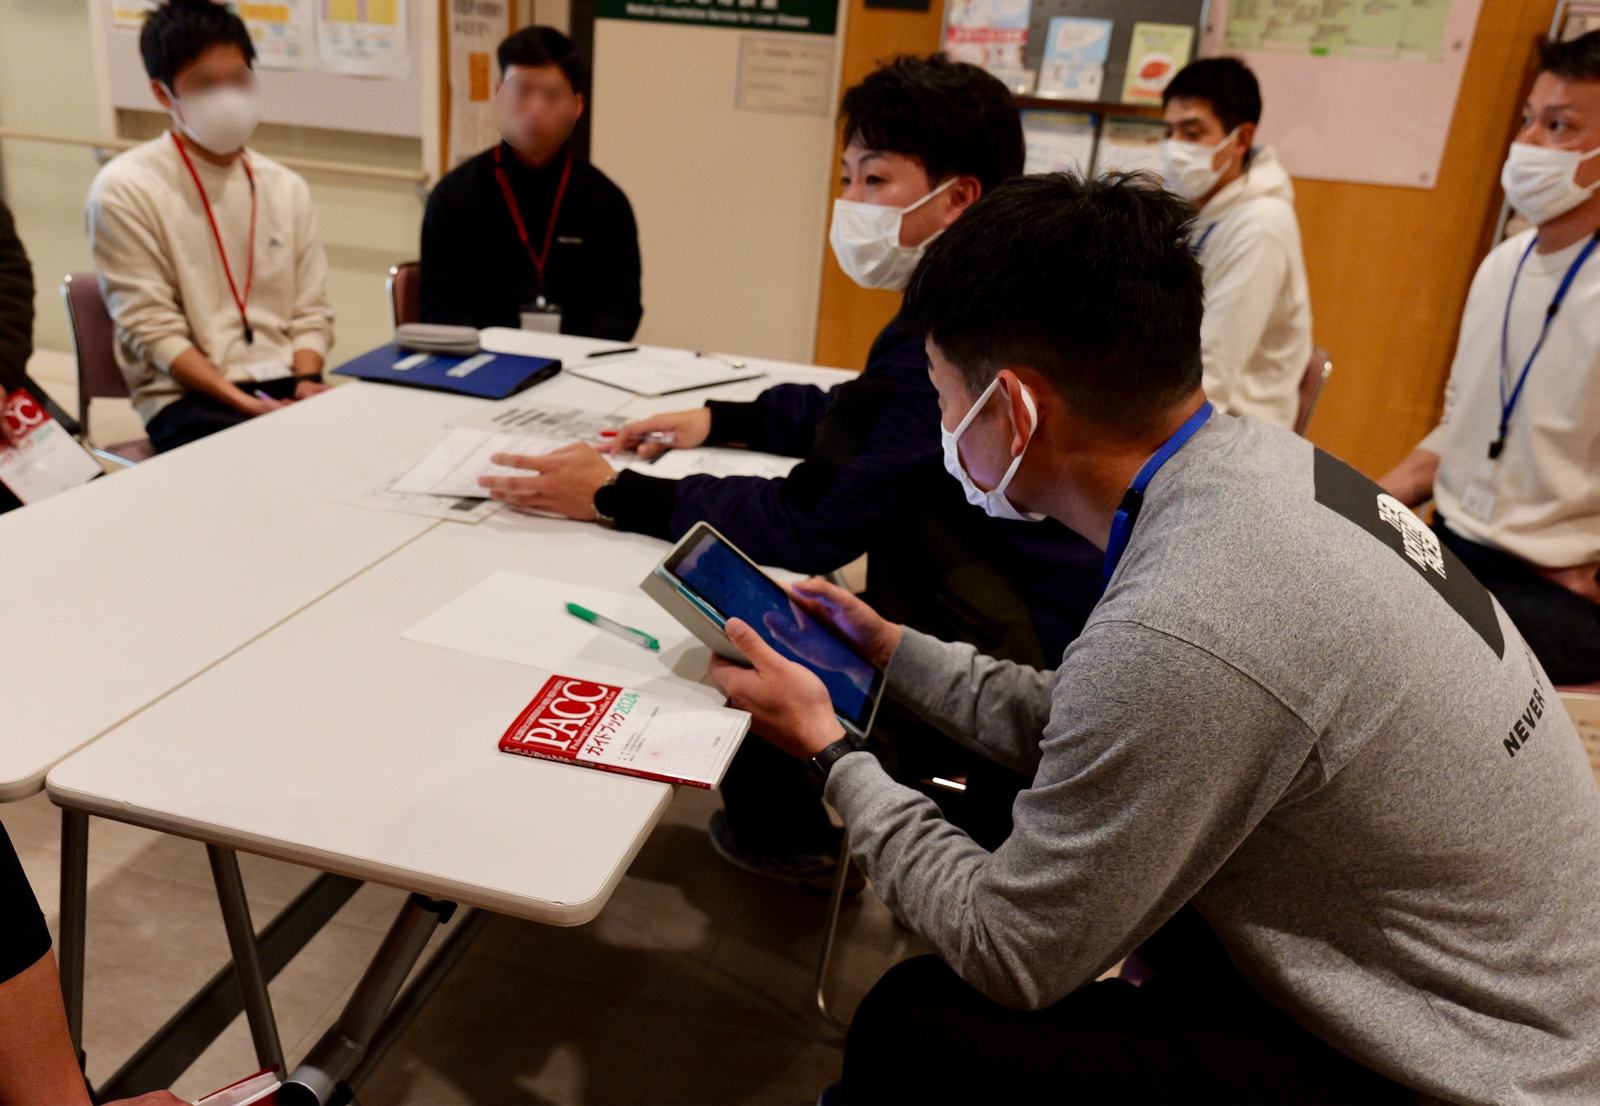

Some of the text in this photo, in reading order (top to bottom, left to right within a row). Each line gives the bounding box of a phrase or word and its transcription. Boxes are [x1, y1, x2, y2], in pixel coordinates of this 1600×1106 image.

[1377, 495, 1402, 533] THE
[1400, 519, 1428, 572] NORTH
[1420, 534, 1447, 580] FACE
[522, 680, 609, 752] PACC
[585, 712, 625, 756] ガイドブック
[613, 692, 641, 715] 2024
[1503, 688, 1546, 758] NEVER
